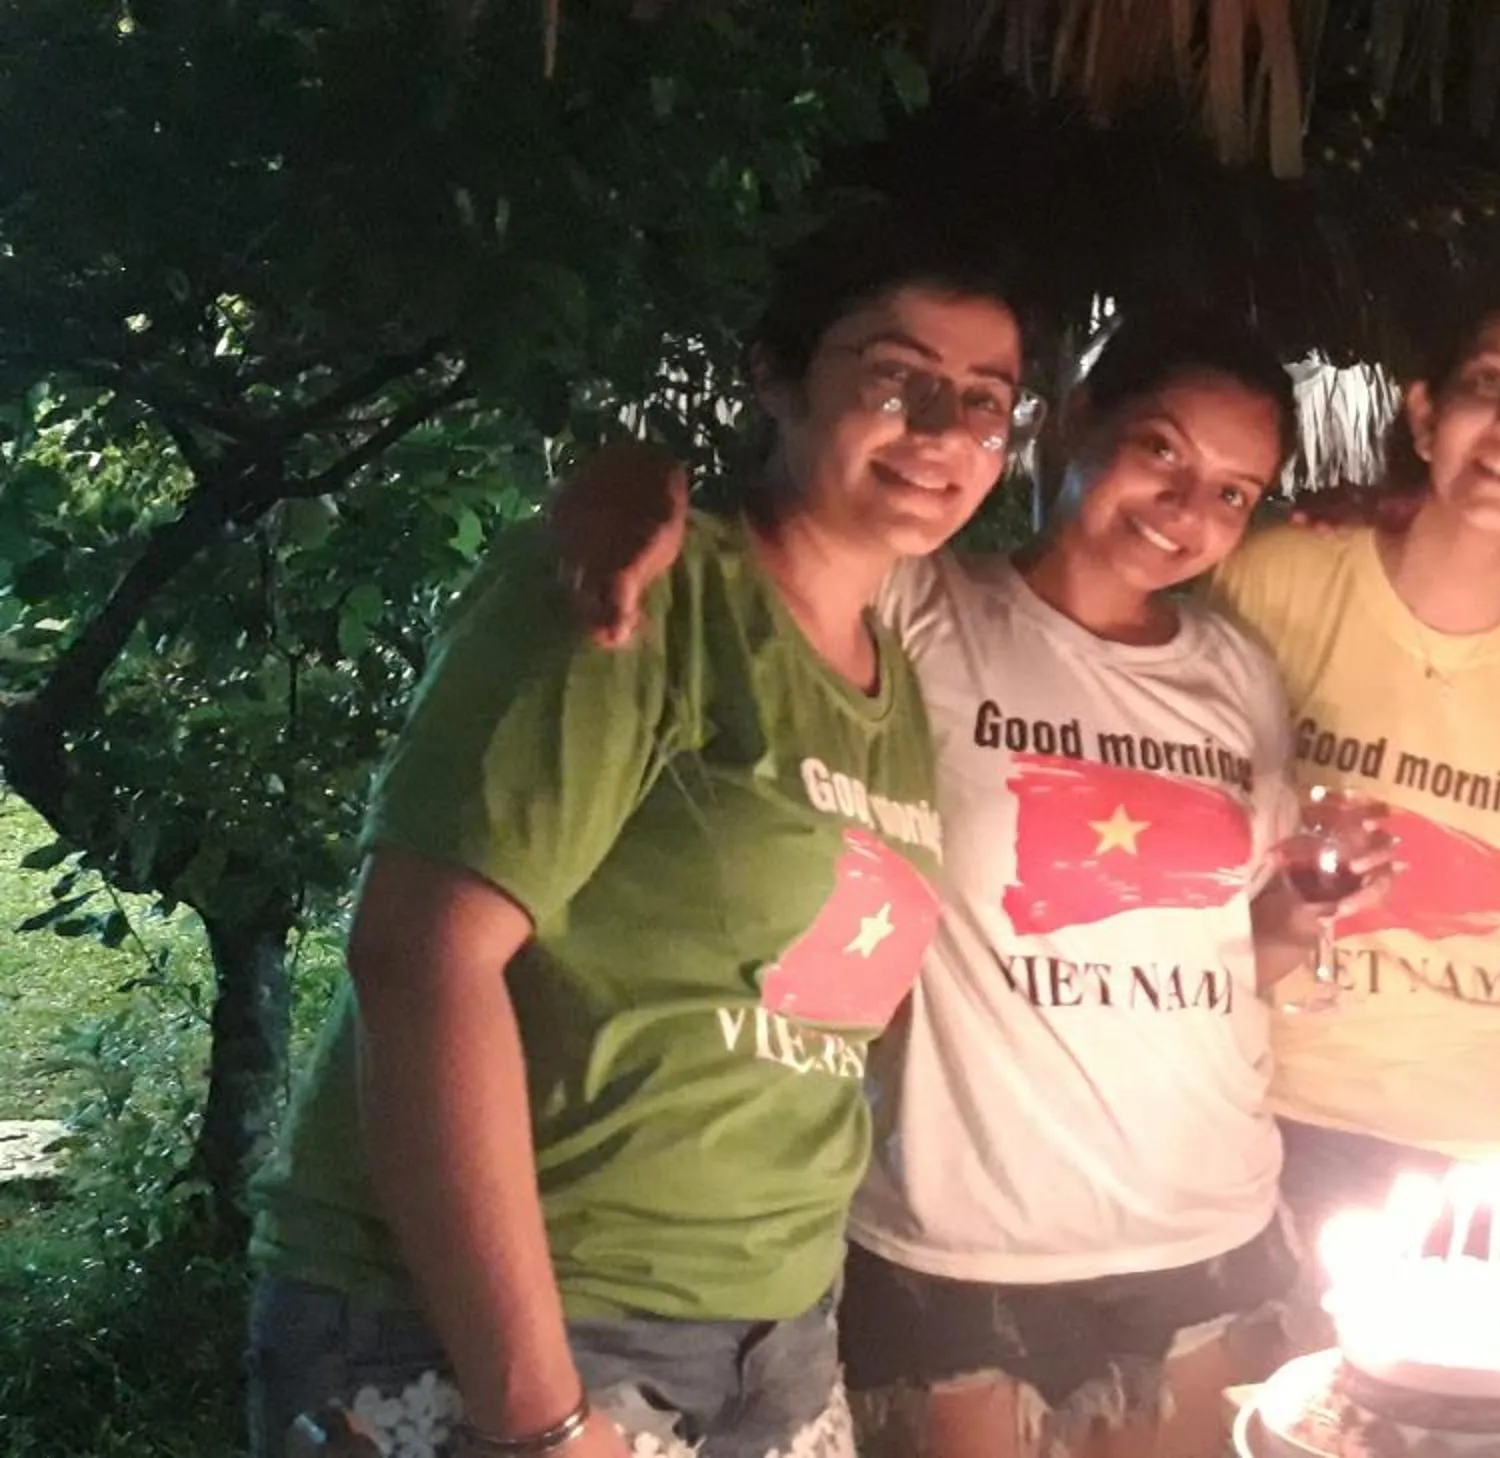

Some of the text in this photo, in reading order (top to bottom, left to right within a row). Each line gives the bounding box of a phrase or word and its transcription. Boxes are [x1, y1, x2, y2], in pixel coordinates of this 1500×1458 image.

[974, 699, 1253, 792] Good morning
[1294, 717, 1387, 779] Good
[1130, 963, 1234, 1014] NAM
